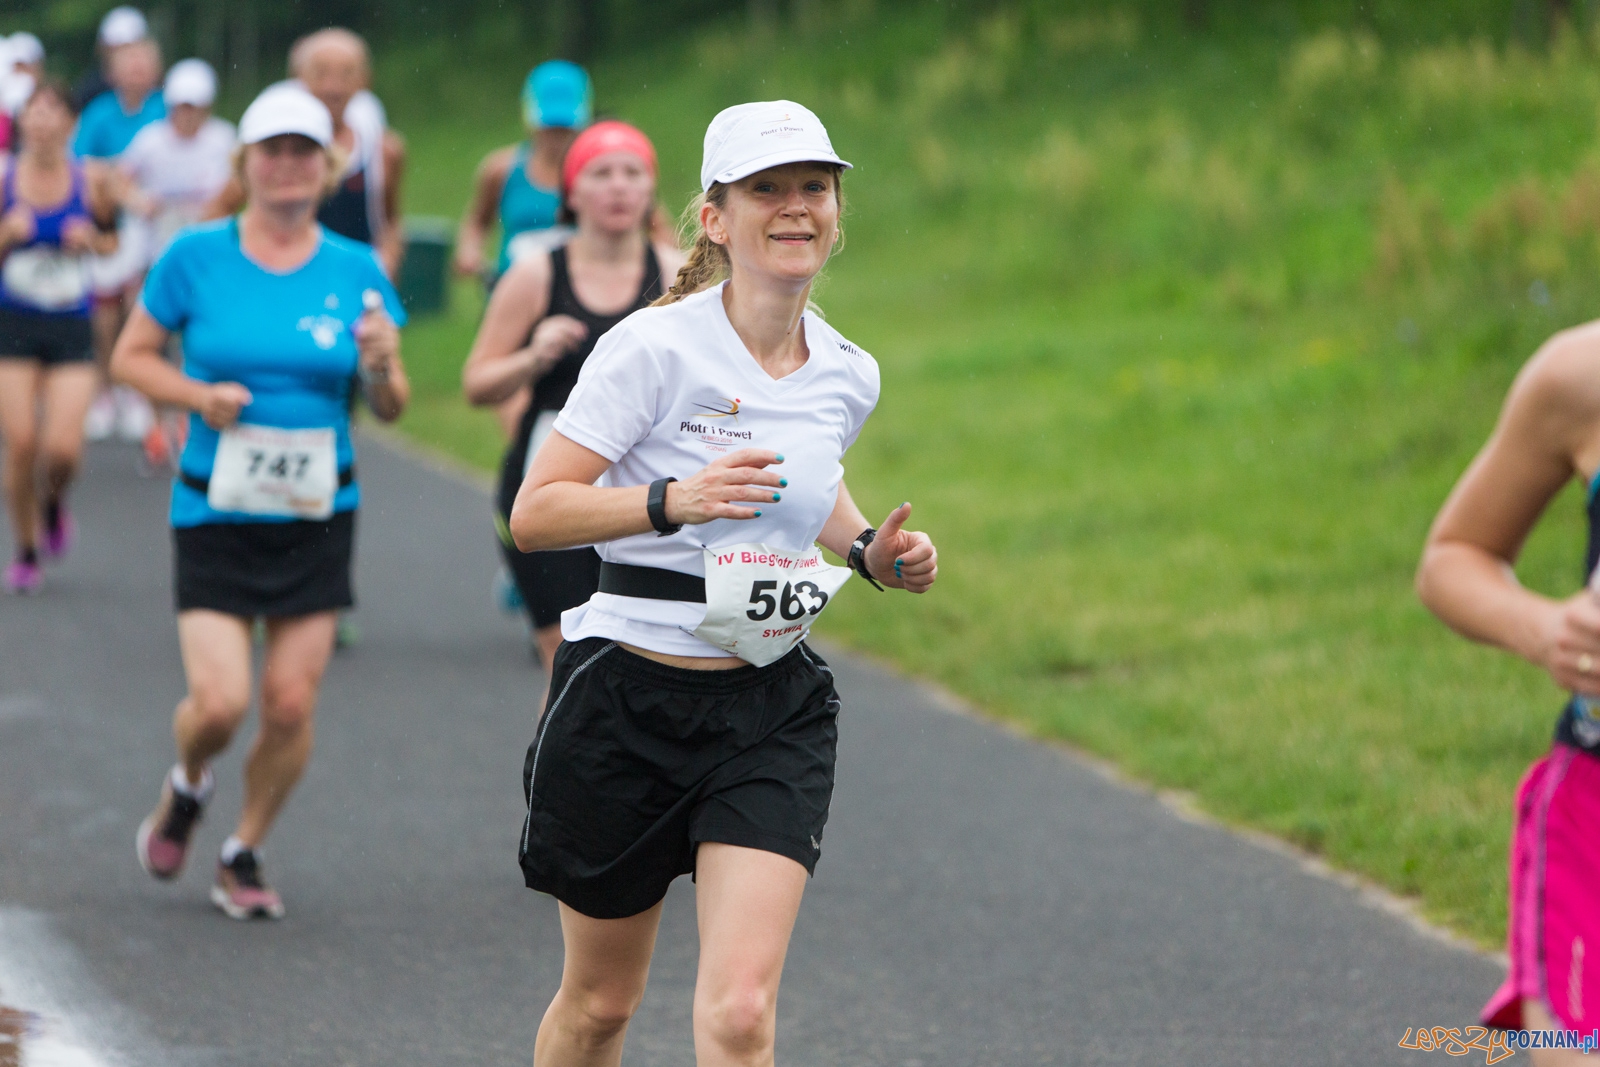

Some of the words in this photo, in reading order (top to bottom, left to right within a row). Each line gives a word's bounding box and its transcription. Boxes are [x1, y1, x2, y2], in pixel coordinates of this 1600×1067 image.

[680, 421, 708, 434] Piotr
[711, 426, 715, 434] i
[718, 427, 752, 440] Paweł
[246, 447, 311, 479] 747
[717, 553, 735, 566] IV
[741, 552, 776, 567] Bieg
[775, 554, 793, 569] iotr
[746, 580, 829, 621] 563
[762, 624, 803, 638] SYLWIA
